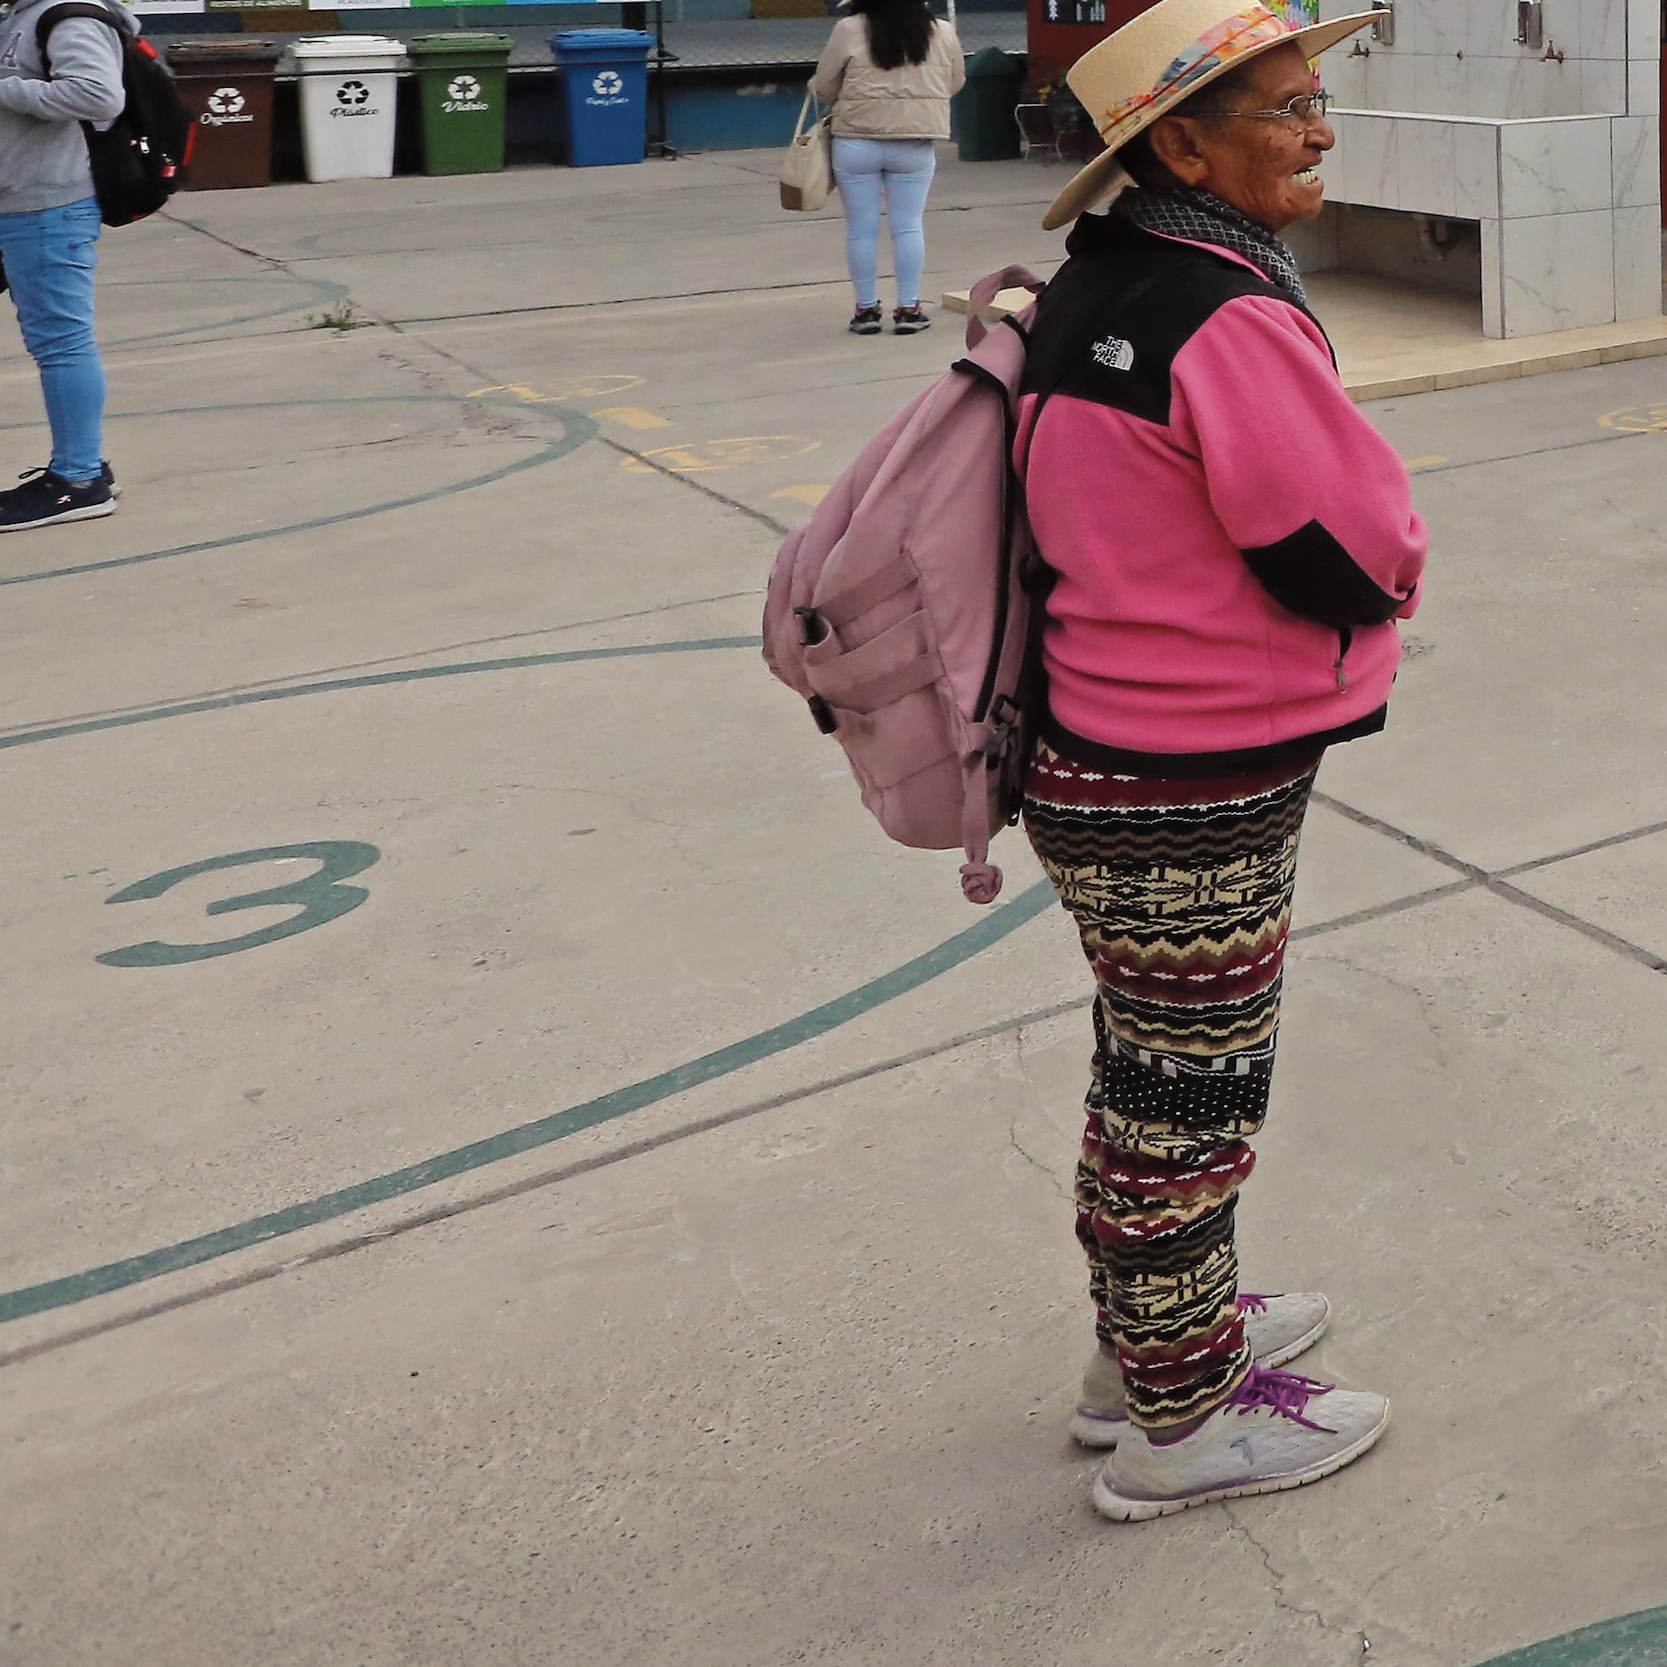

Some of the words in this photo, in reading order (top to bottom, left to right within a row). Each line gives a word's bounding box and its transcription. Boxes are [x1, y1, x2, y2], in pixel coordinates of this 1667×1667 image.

[1091, 341, 1119, 358] NORTH
[1106, 335, 1121, 349] THE
[1092, 352, 1117, 366] FACE
[95, 839, 382, 968] 3
